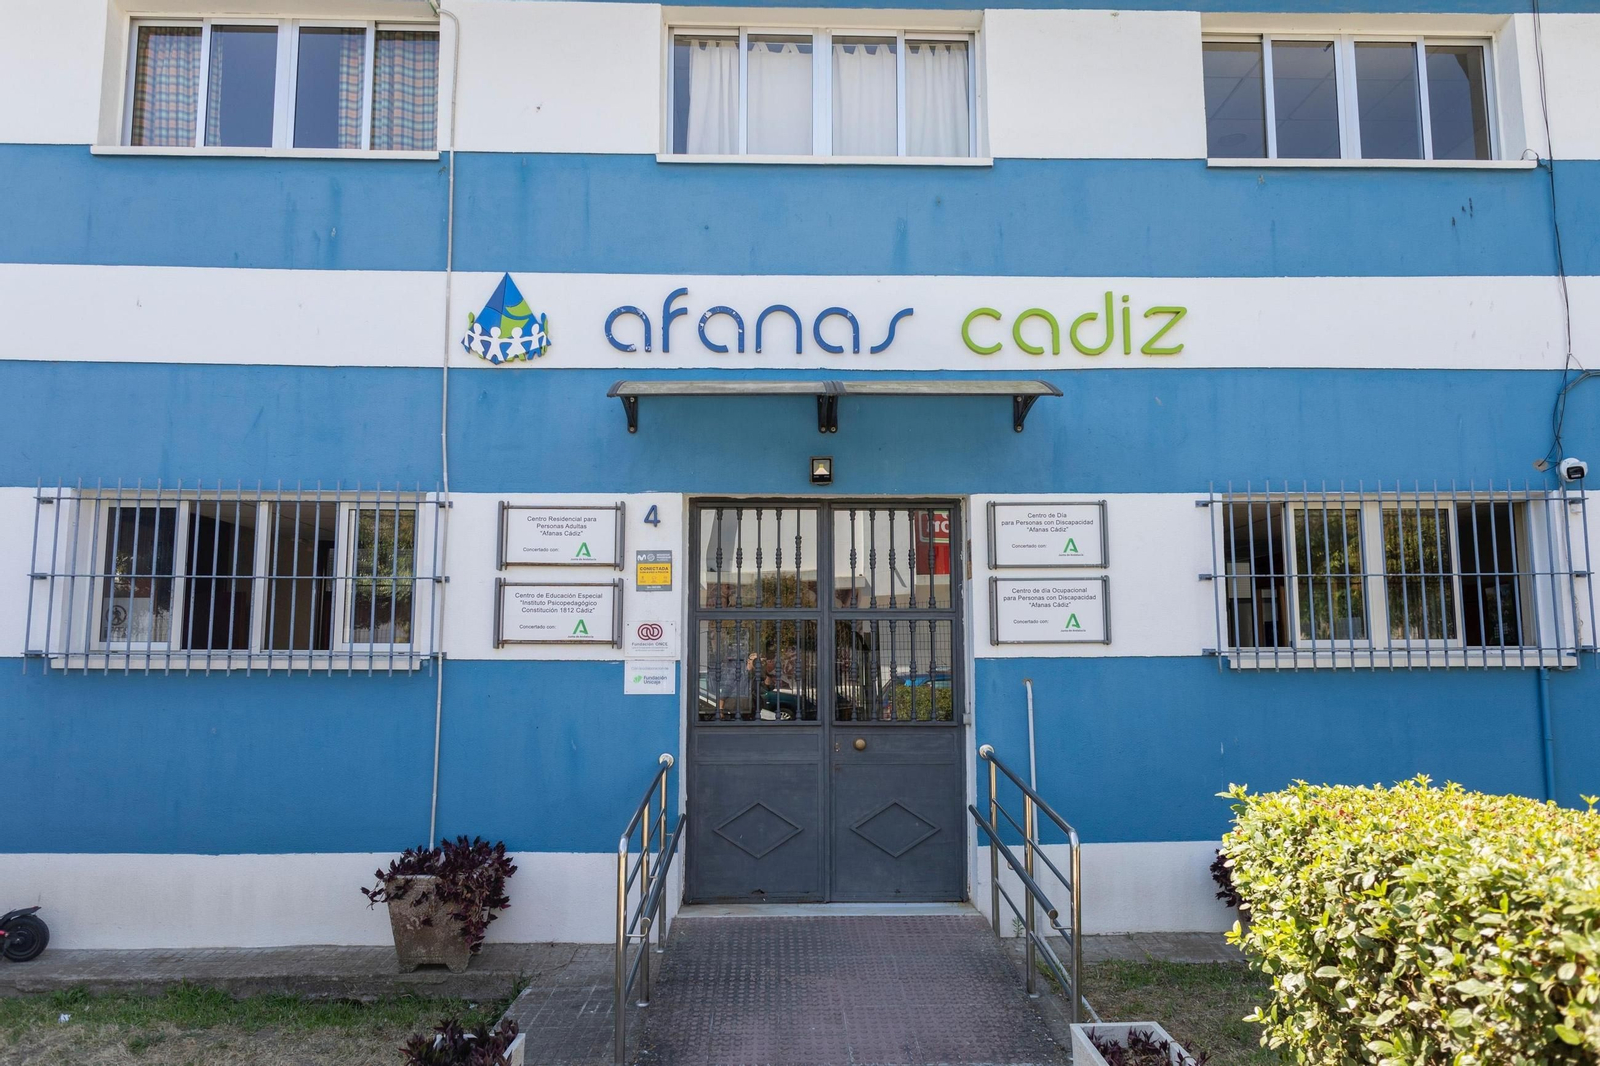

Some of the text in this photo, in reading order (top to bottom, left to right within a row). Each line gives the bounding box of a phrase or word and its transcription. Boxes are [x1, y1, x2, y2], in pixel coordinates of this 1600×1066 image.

[605, 287, 1188, 356] afanas cadiz
[644, 505, 661, 527] 4
